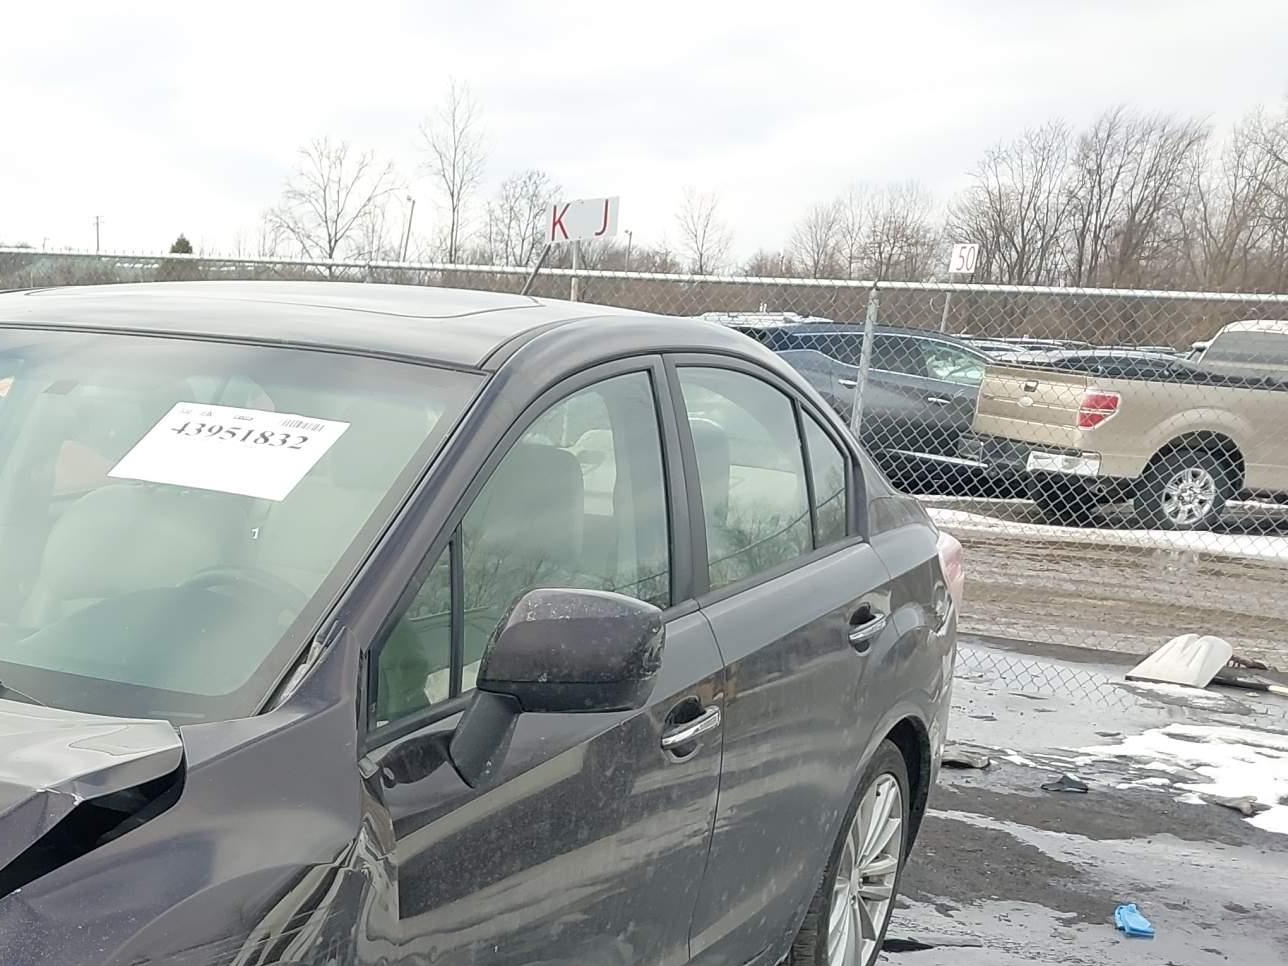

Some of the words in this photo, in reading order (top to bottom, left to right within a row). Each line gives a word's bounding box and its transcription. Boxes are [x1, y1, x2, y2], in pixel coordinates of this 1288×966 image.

[551, 203, 571, 241] K
[594, 199, 609, 236] J
[955, 246, 976, 271] 50
[171, 421, 309, 450] 43951832
